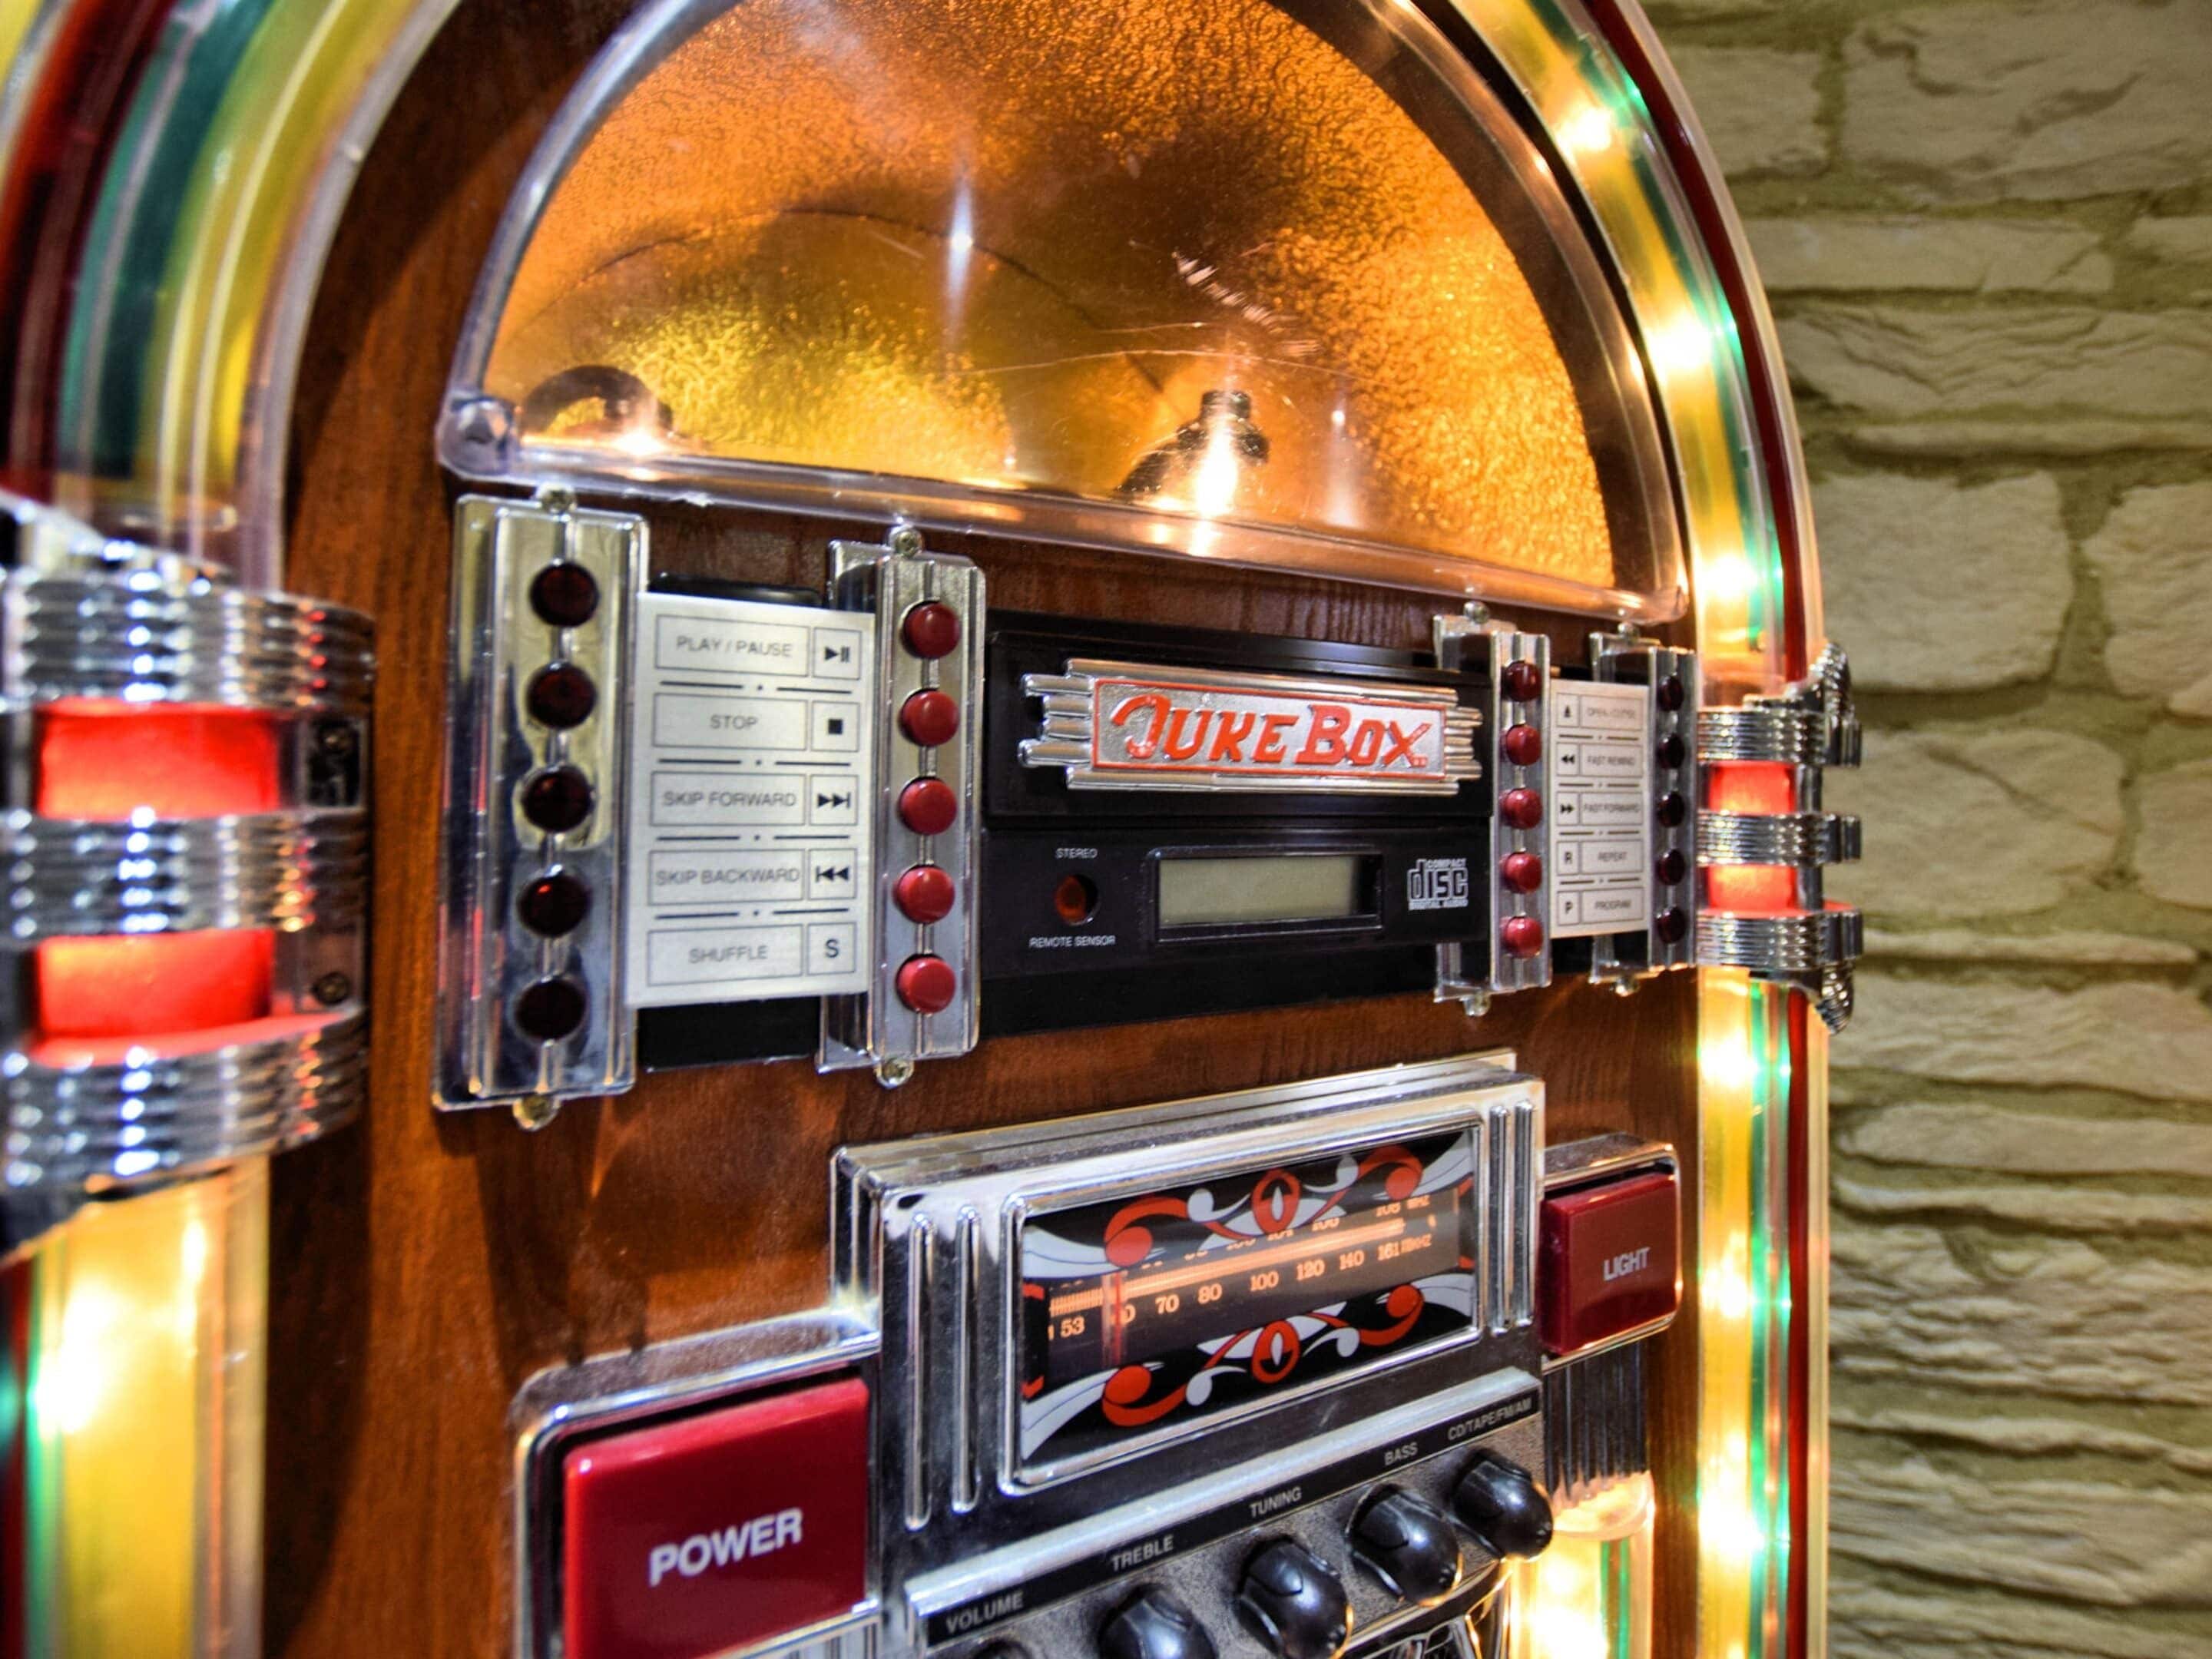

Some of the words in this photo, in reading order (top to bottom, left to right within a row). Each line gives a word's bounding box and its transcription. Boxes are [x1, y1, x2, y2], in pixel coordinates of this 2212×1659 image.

[676, 635, 722, 652] PLAY
[736, 641, 794, 658] PAUSE
[709, 714, 759, 730] STOP
[663, 791, 704, 807] SKIP
[708, 791, 796, 807] FORWARD
[1055, 848, 1098, 859] STEREO
[1564, 851, 1573, 865] R
[655, 869, 697, 886] SKIP
[700, 867, 800, 885] BACKWARD
[1565, 901, 1573, 914] P
[825, 938, 839, 958] S
[1029, 936, 1073, 949] REMOTE
[1075, 935, 1117, 947] SENSOR
[689, 945, 768, 964] SHUFFLE
[1602, 1246, 1651, 1282] LIGHT
[1061, 1316, 1085, 1338] 53
[1155, 1293, 1180, 1314] 70
[1197, 1283, 1223, 1304] 80
[1250, 1271, 1280, 1292] 100
[1296, 1260, 1326, 1281] 120
[1339, 1250, 1366, 1271] 140
[1384, 1441, 1419, 1465] BASS
[1248, 1485, 1303, 1518] TUNING
[648, 1505, 803, 1588] POWER
[1111, 1534, 1175, 1573] TREBLE
[945, 1591, 1024, 1634] VOLUME
